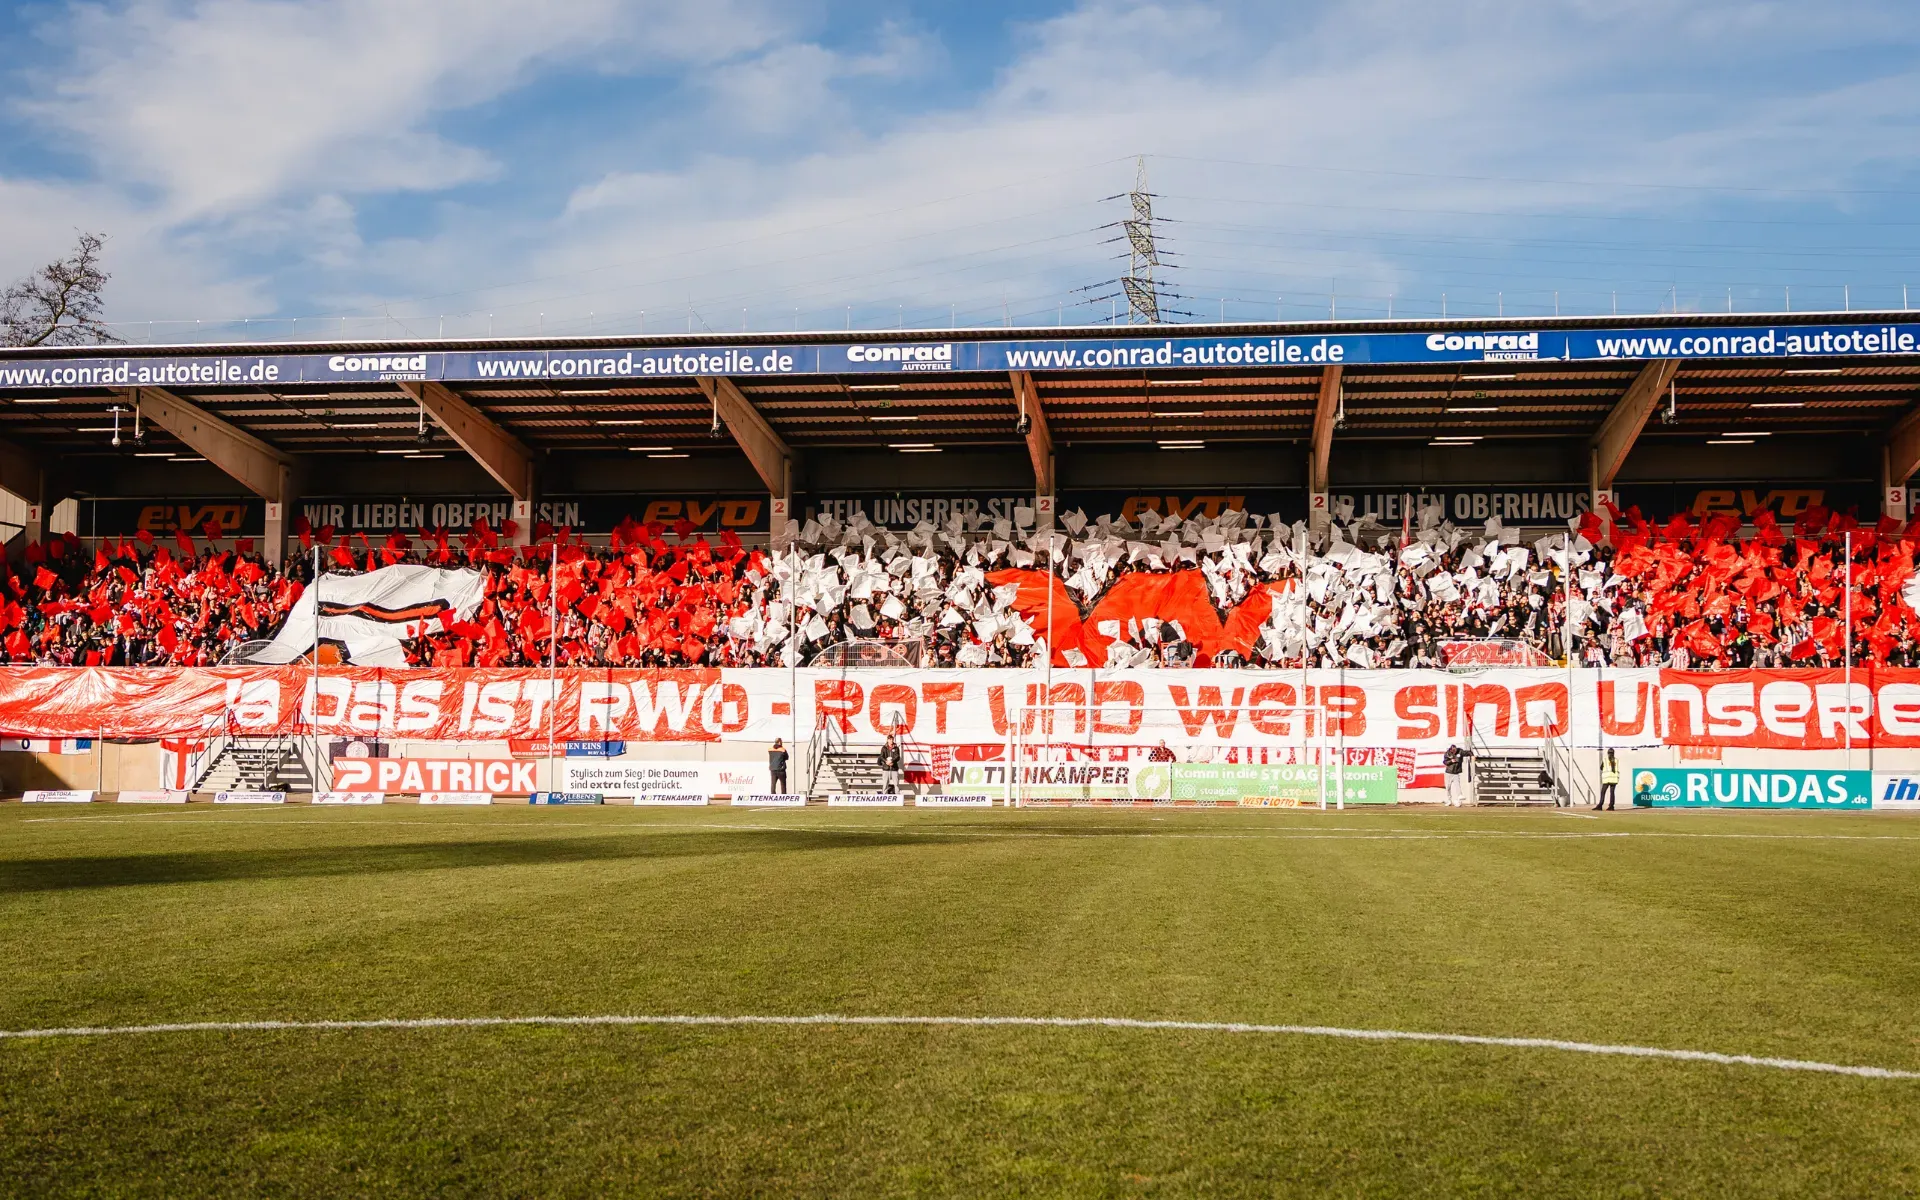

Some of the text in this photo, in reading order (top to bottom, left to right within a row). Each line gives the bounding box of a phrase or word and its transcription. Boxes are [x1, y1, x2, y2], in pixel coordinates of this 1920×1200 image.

[1426, 333, 1538, 351] Conrad
[847, 344, 951, 362] Conrad
[1006, 340, 1343, 368] www.conrad-autoteile.de
[1485, 351, 1538, 360] AUTOTEILE
[329, 355, 427, 371] Conrad
[477, 350, 793, 377] www.conrad-autoteile.de
[902, 363, 951, 371] AUTOTEILE
[379, 372, 426, 380] AUTOTEILE
[1314, 496, 1324, 508] 2
[1598, 493, 1609, 506] 2
[1890, 490, 1902, 502] 3
[518, 504, 525, 516] 1
[774, 502, 784, 513] 2
[874, 498, 979, 525] UNSERER
[1040, 499, 1050, 511] 2
[30, 508, 37, 520] 1
[136, 505, 248, 530] evo
[270, 506, 277, 518] 1
[303, 502, 585, 528] WIR LIEBEN OBERHSEN.
[642, 500, 762, 527] evo
[579, 680, 749, 734] RWO
[815, 680, 965, 735] ROT
[582, 742, 602, 750] EINS
[378, 760, 536, 791] PATRICK
[570, 769, 603, 780] Stylisch
[625, 769, 645, 780] Sieg!
[648, 769, 661, 778] Die
[664, 769, 699, 778] Daumen
[719, 772, 755, 785] Westfield
[1222, 768, 1235, 778] in
[1237, 768, 1259, 779] die
[1261, 767, 1318, 781] STOAG
[570, 780, 682, 791] sind extra fest gedrückt.
